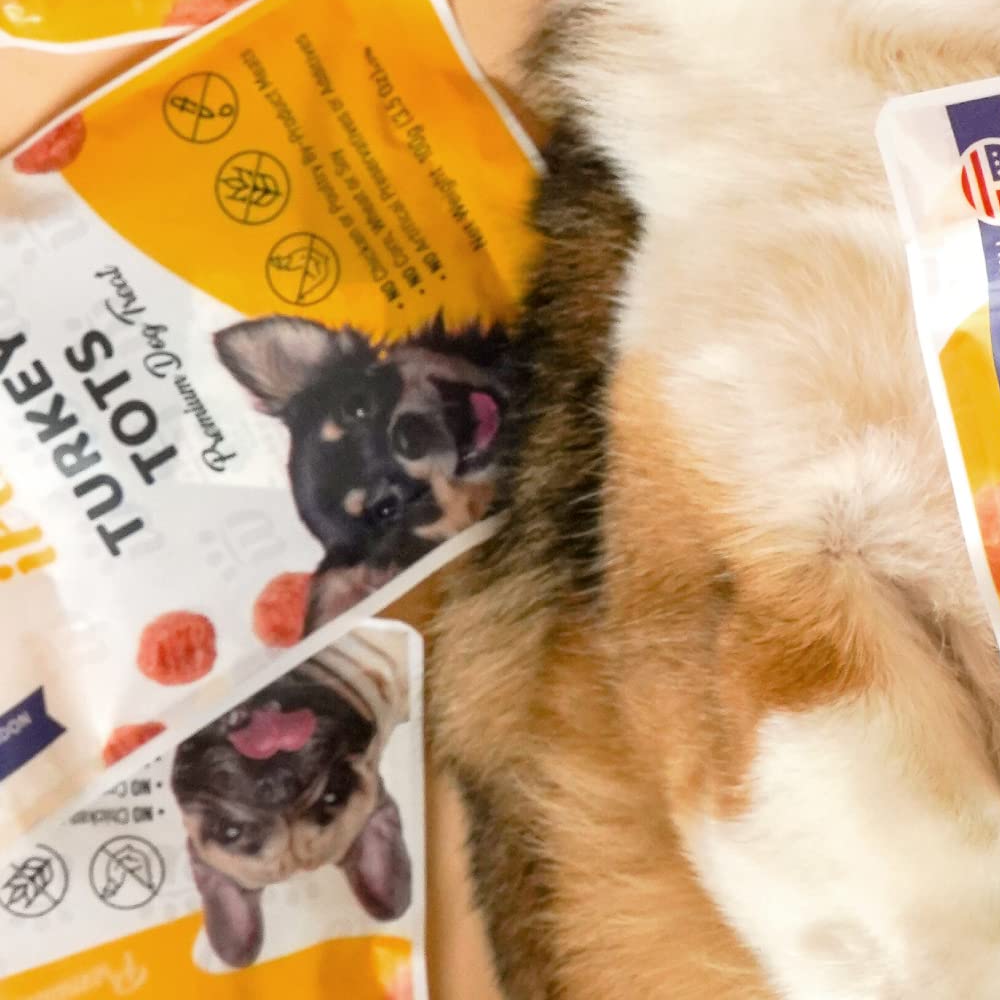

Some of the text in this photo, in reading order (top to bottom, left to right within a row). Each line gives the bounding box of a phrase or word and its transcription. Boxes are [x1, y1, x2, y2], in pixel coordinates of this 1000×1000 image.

[402, 265, 422, 288] NO
[422, 250, 443, 275] NO
[380, 279, 401, 303] NO
[95, 265, 237, 473] Premium Dog Treat
[65, 330, 178, 486] TOTS
[0, 331, 144, 557] TURKEY
[0, 711, 32, 743] DON
